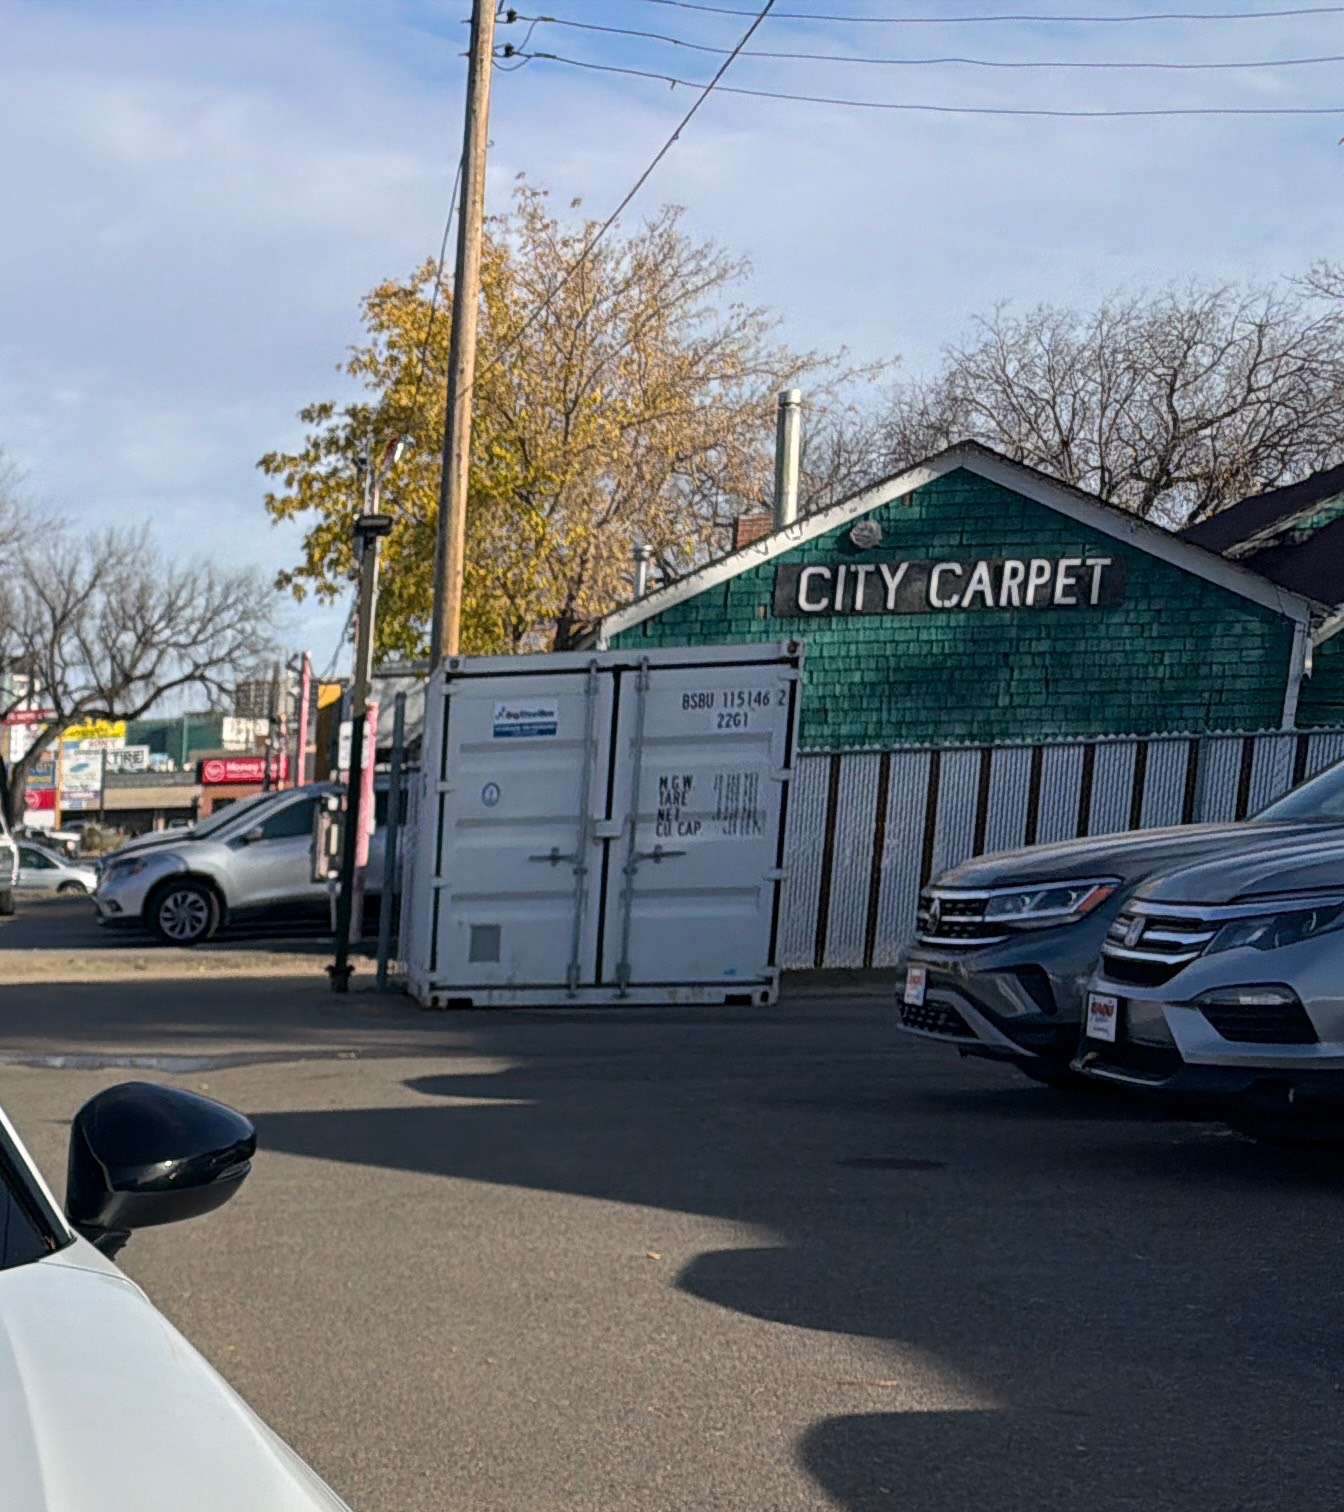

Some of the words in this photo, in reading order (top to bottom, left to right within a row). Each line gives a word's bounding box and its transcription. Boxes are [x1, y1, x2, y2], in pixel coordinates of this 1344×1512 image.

[798, 561, 910, 612] CITY
[929, 558, 1111, 609] CARPET
[682, 692, 714, 710] BSBU
[723, 690, 771, 708] 115146
[777, 689, 786, 706] 2
[717, 712, 748, 729] 22G1
[656, 807, 680, 822] NET
